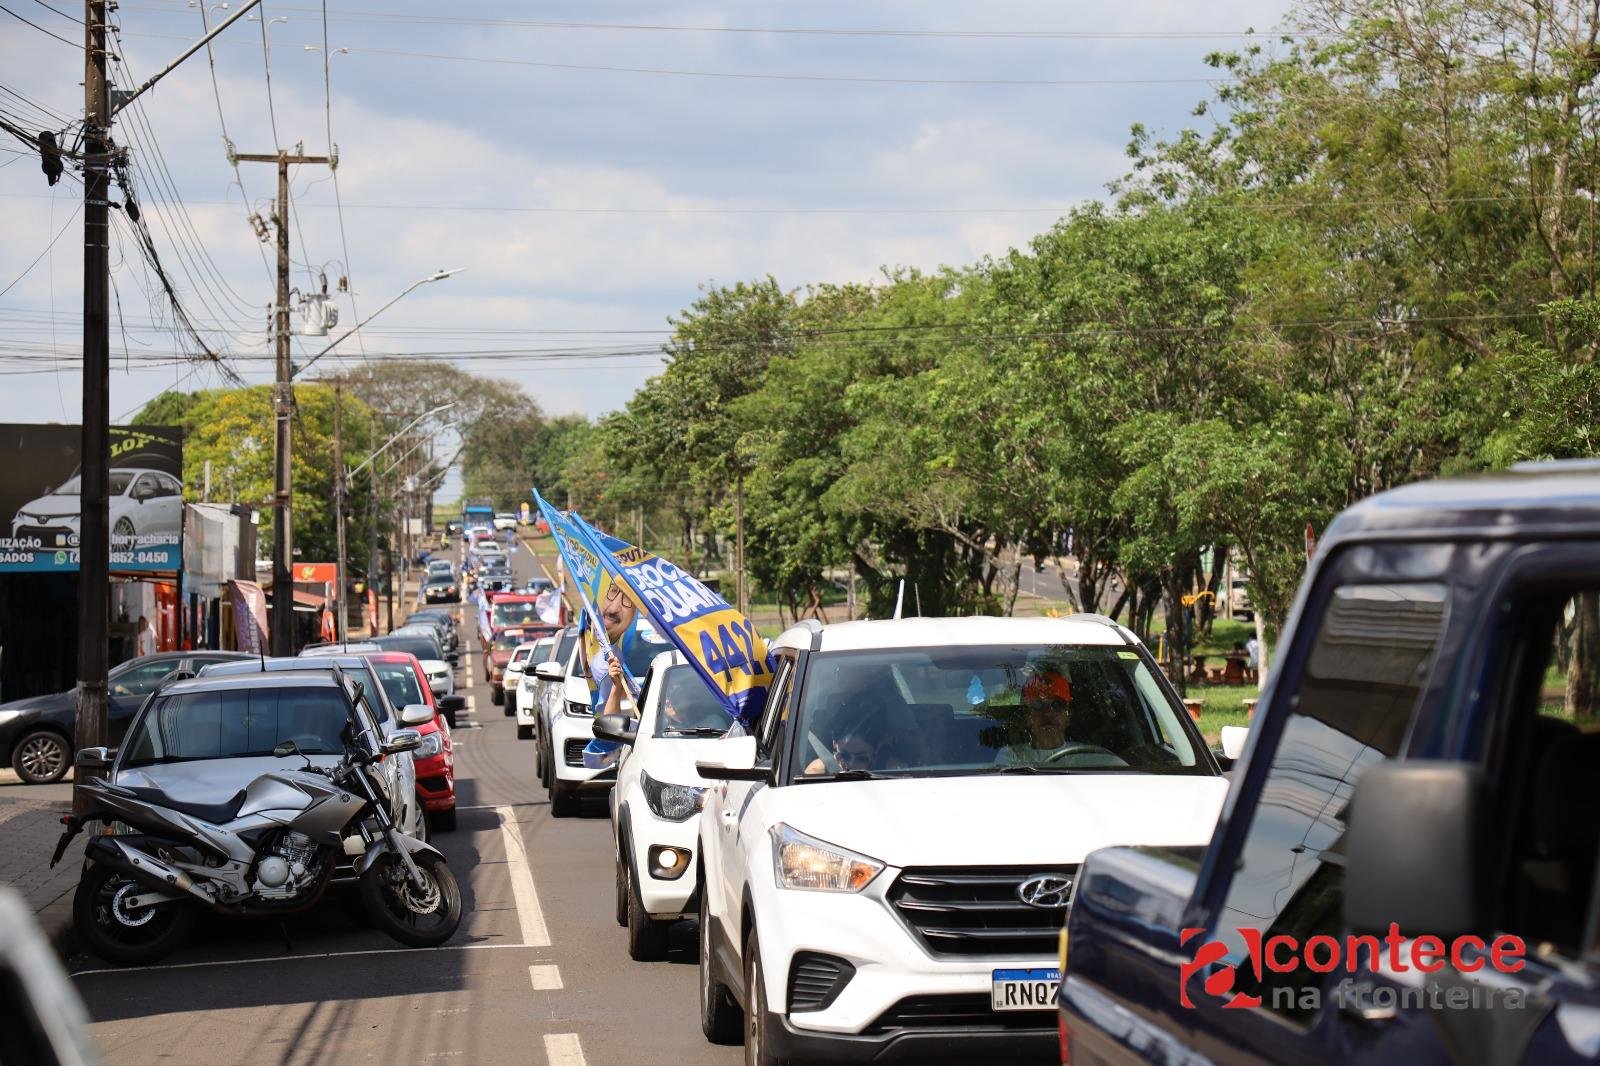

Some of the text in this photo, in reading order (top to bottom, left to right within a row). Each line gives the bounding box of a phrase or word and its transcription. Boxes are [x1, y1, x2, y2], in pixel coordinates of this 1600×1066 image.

[625, 557, 690, 591] DEOC
[643, 577, 727, 622] DUAR
[1005, 982, 1060, 1006] RNQ7
